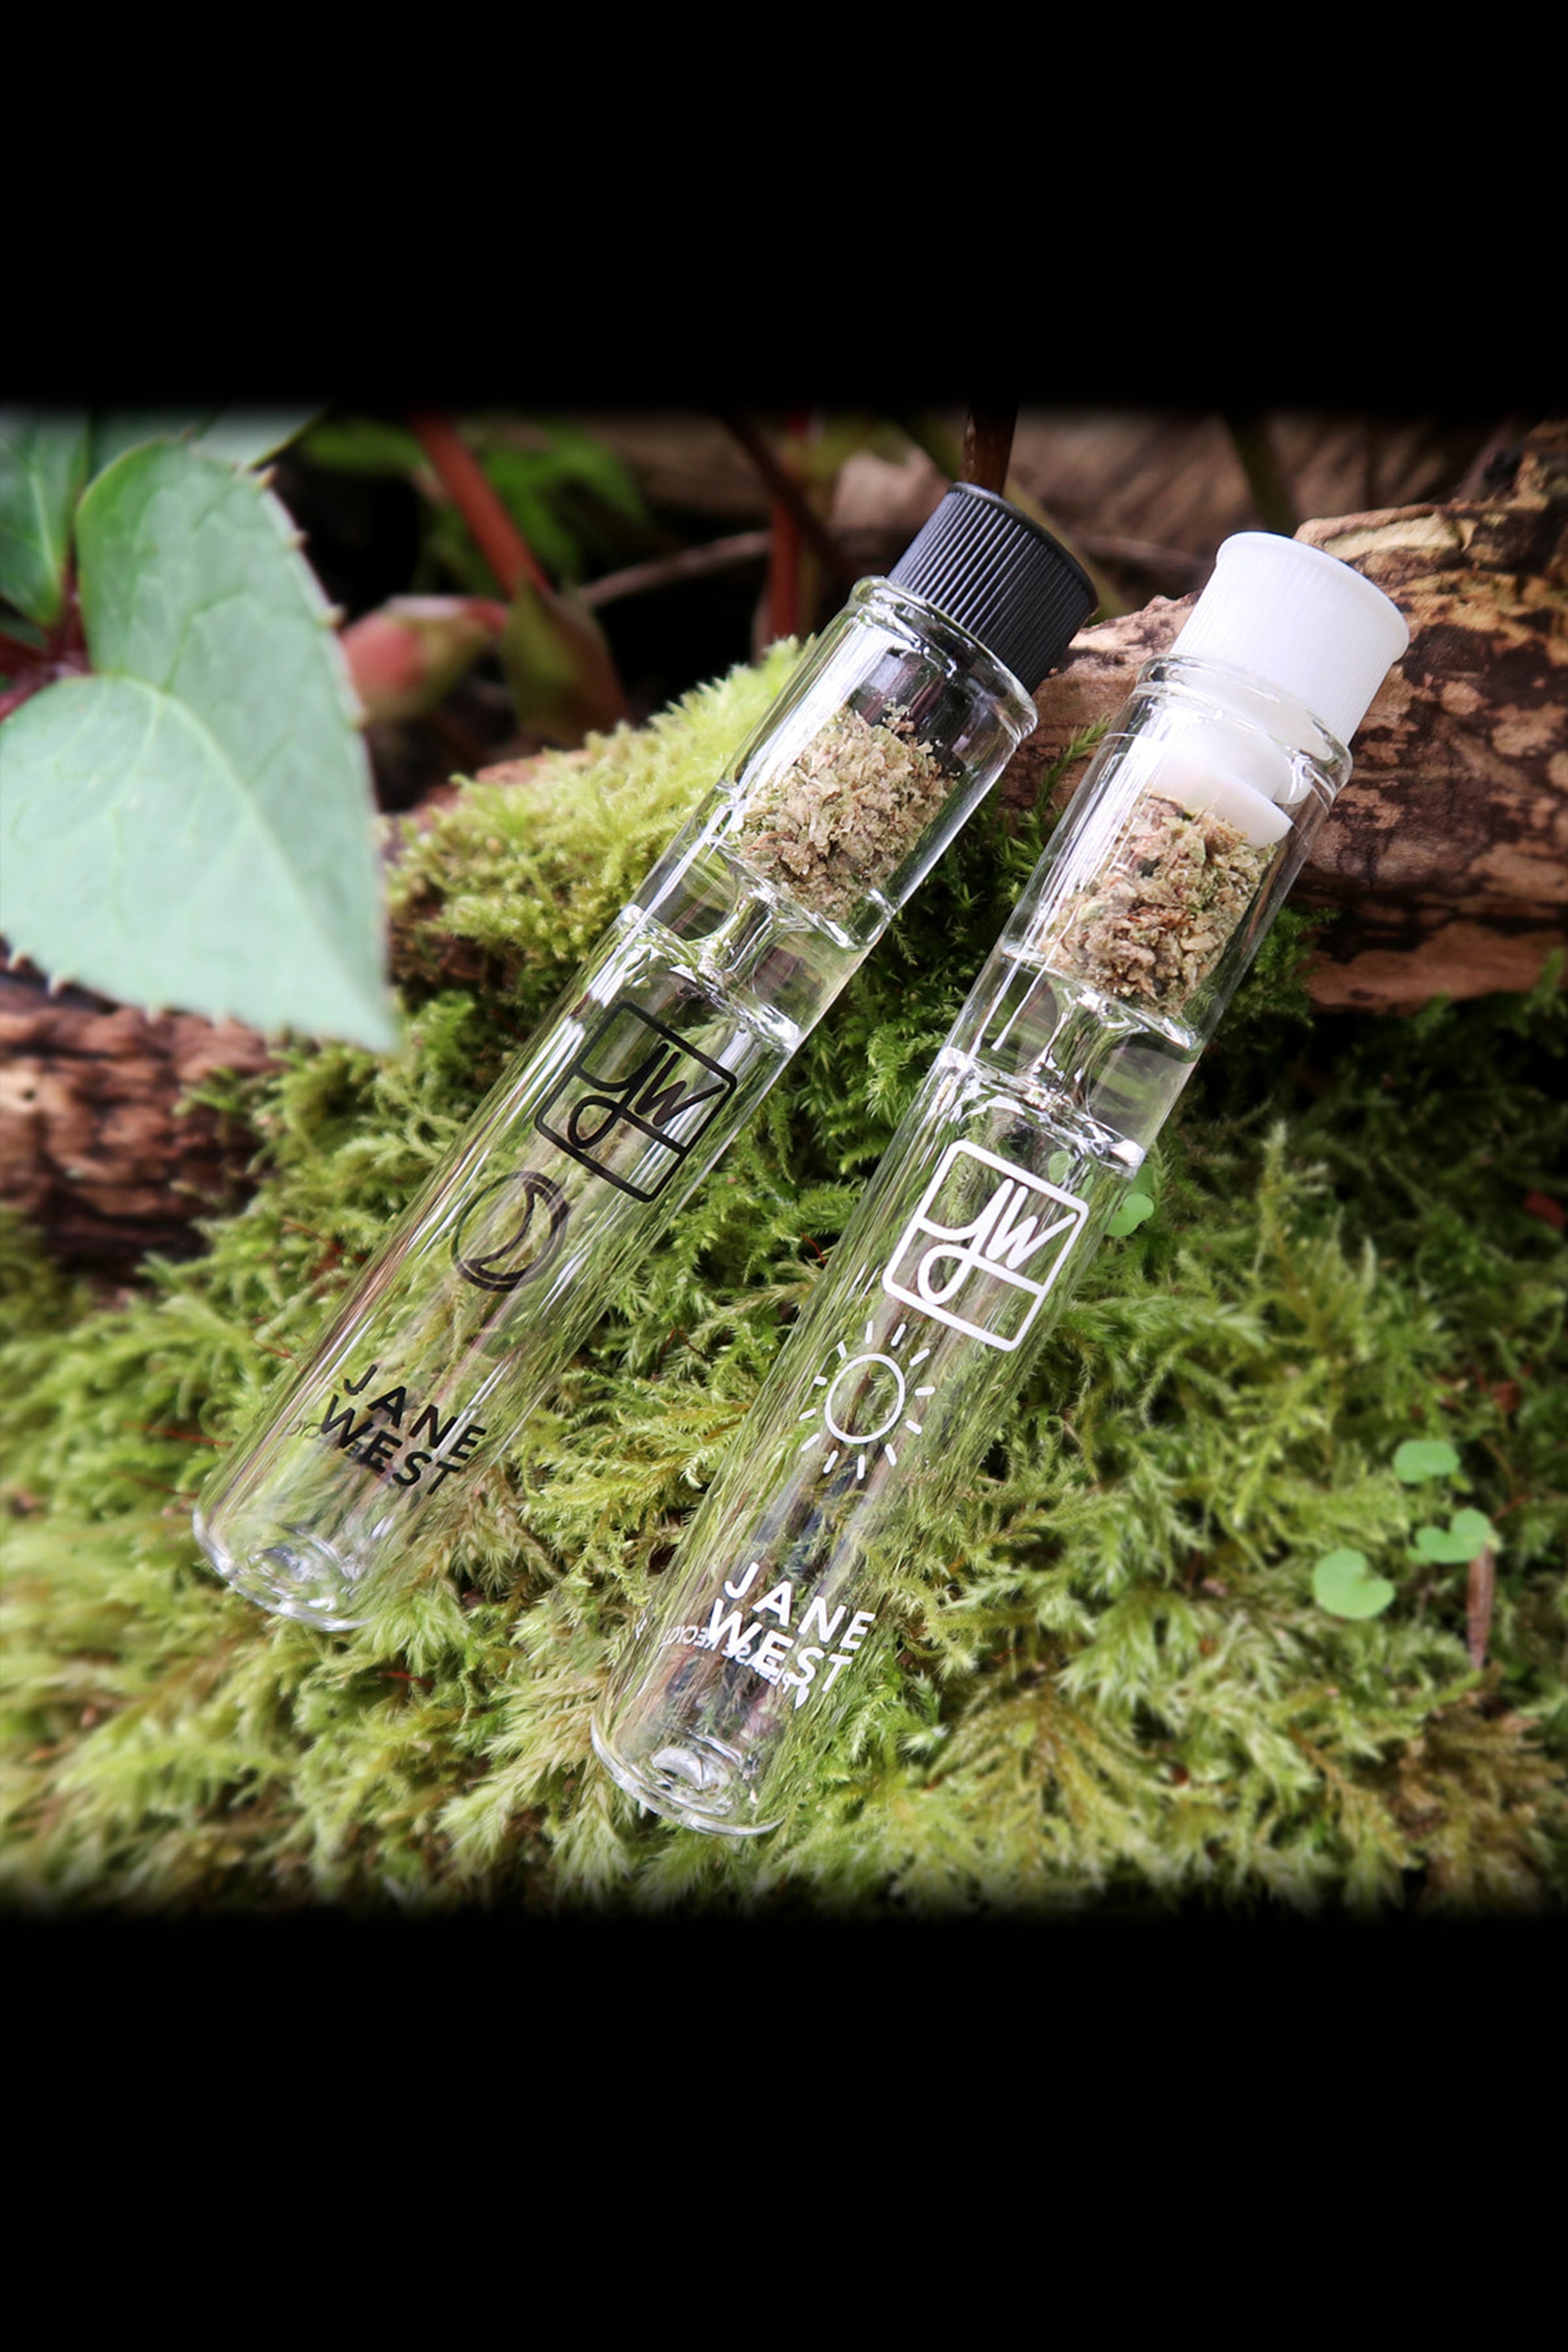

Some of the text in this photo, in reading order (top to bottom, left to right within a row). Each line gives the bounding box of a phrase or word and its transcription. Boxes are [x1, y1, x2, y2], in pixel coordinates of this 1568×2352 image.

[320, 1394, 461, 1495] WEST
[343, 1364, 487, 1460] JANE
[708, 1598, 853, 1692] WEST
[724, 1562, 875, 1649] JANE
